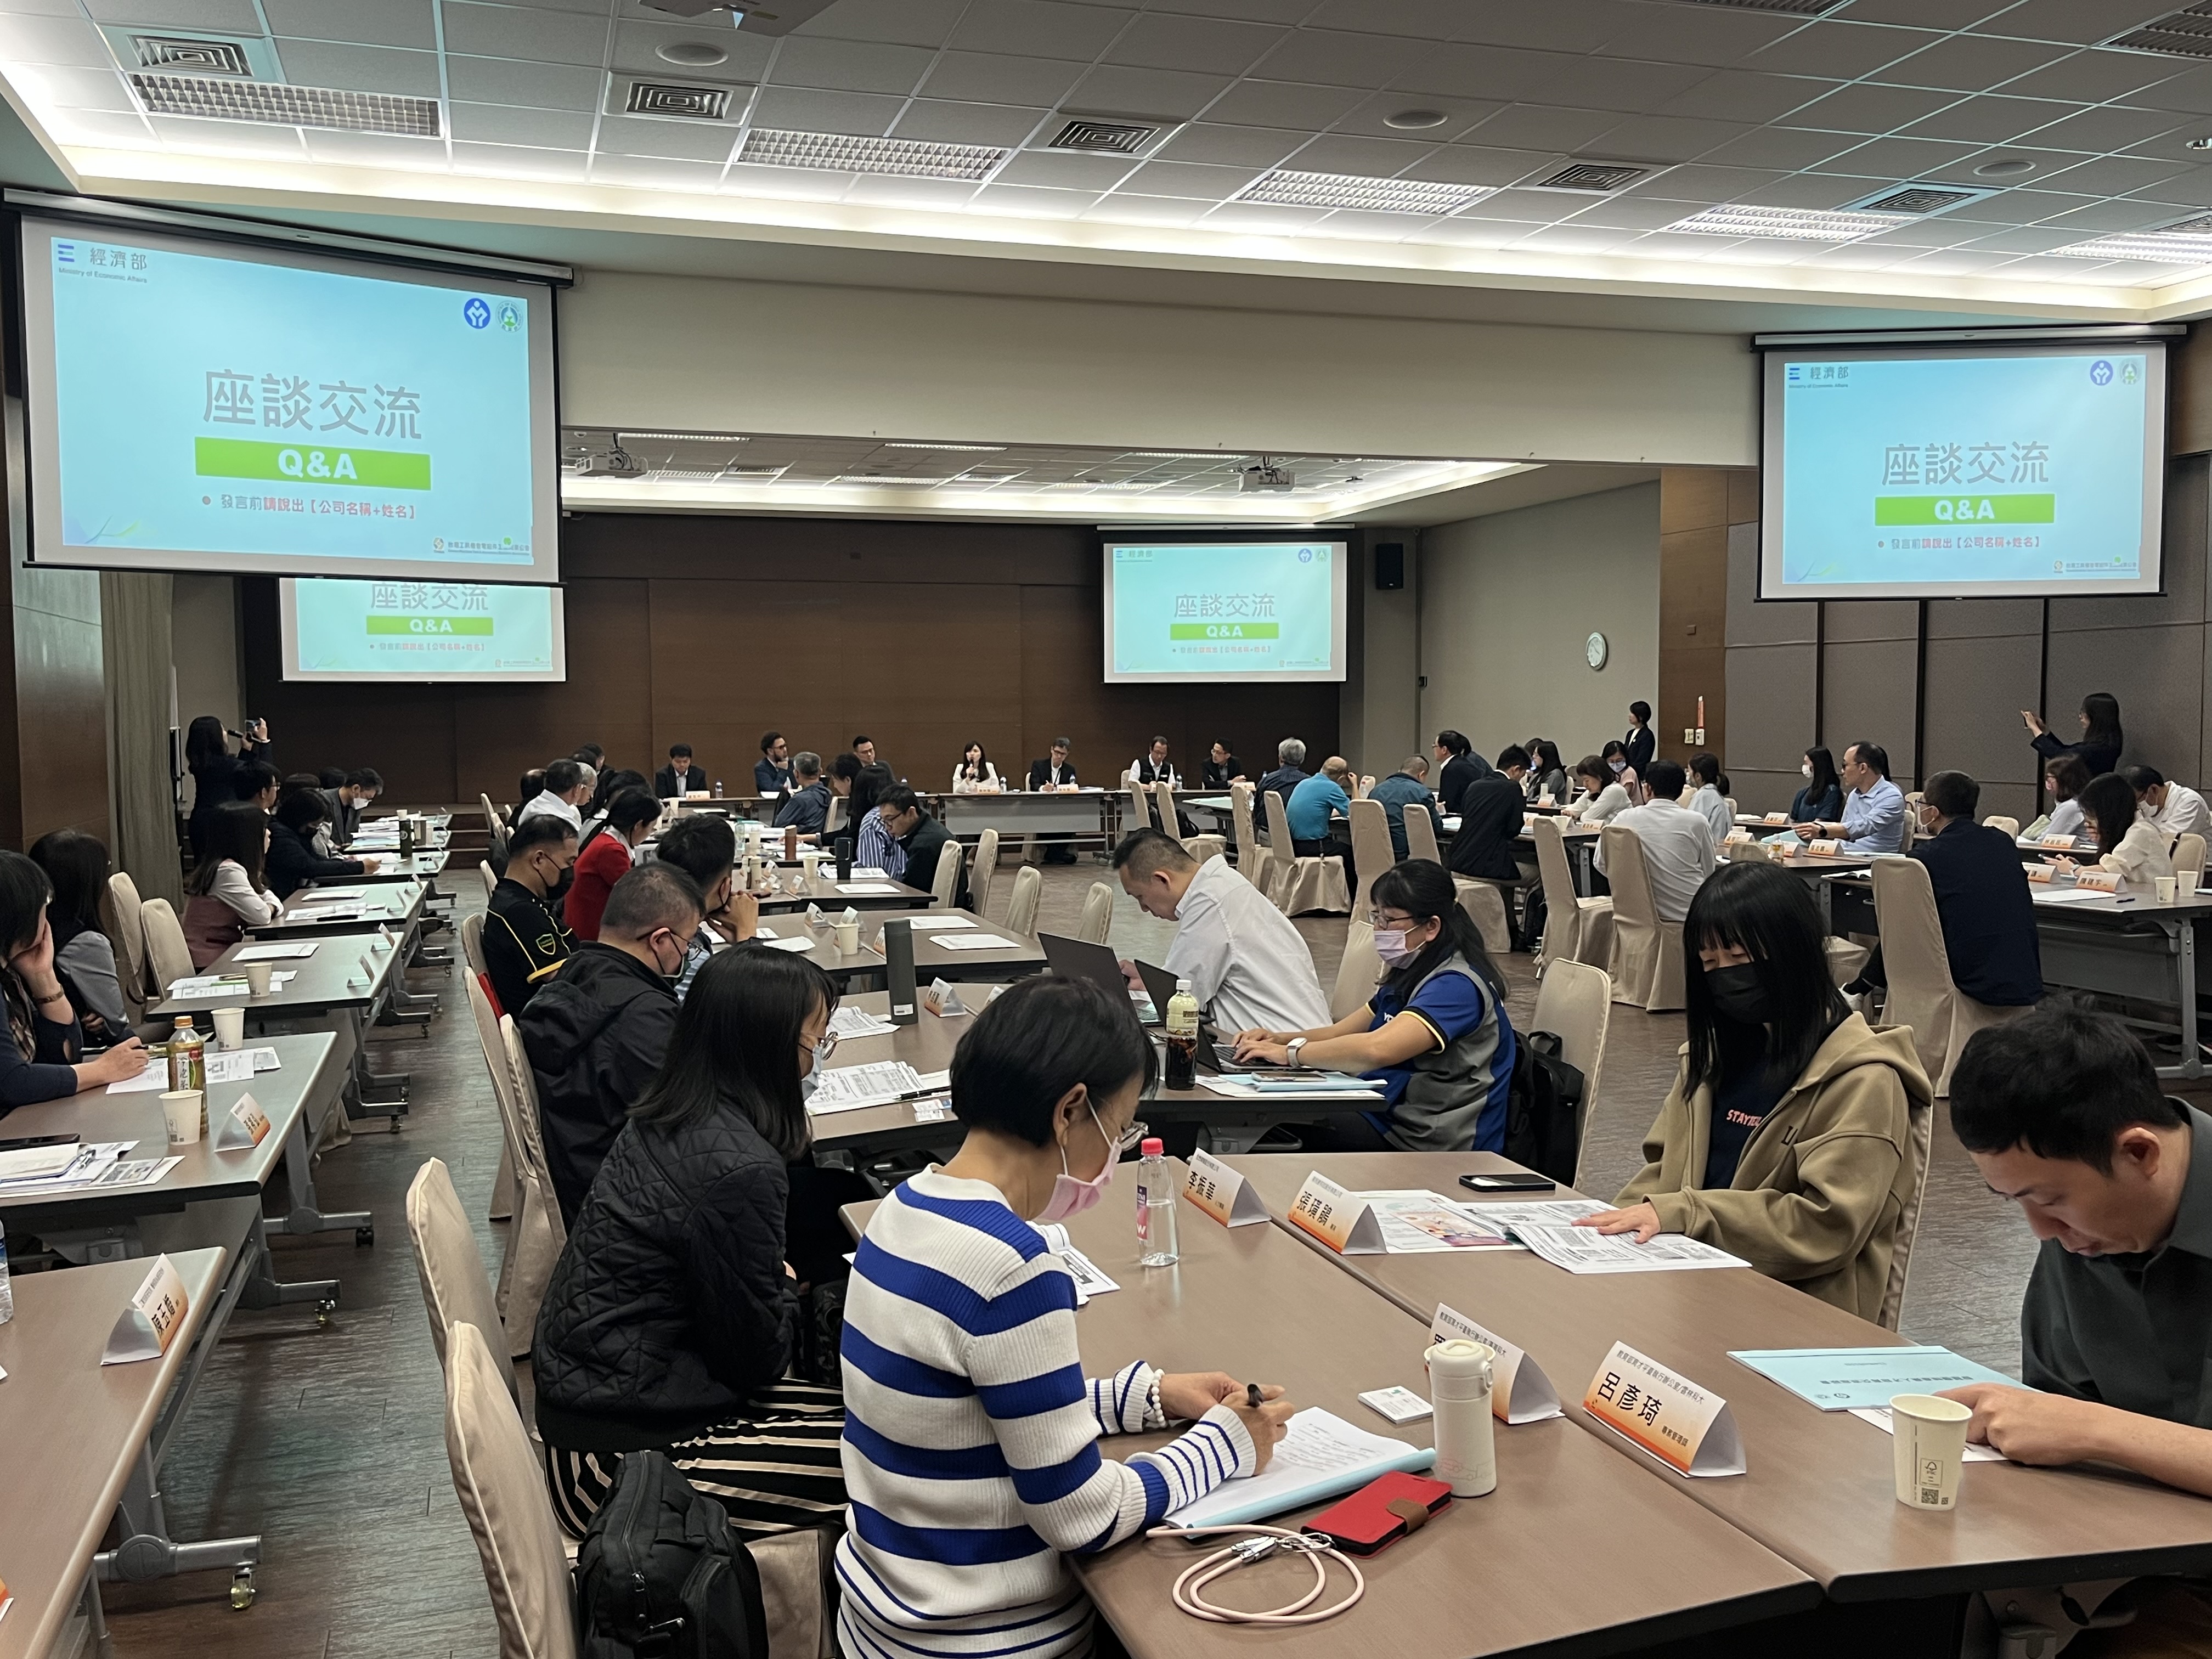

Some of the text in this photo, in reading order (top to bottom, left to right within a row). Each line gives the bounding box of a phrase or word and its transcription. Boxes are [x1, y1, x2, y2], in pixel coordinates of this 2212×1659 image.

[90, 247, 147, 270] 經濟部
[59, 267, 85, 277] Ministry
[94, 271, 126, 281] Economic
[127, 275, 148, 284] Affairs
[1810, 366, 1849, 380] 經濟部
[203, 369, 422, 439] 座談交流
[278, 449, 358, 481] Q&A
[1882, 441, 2049, 486] 座談交流
[1934, 499, 1995, 521] Q&A
[371, 582, 488, 610] 座談交流
[1174, 593, 1275, 618] 座談交流
[409, 618, 453, 633] Q&A
[1206, 625, 1244, 637] Q&A
[1597, 1371, 1663, 1426] 呂彥琦
